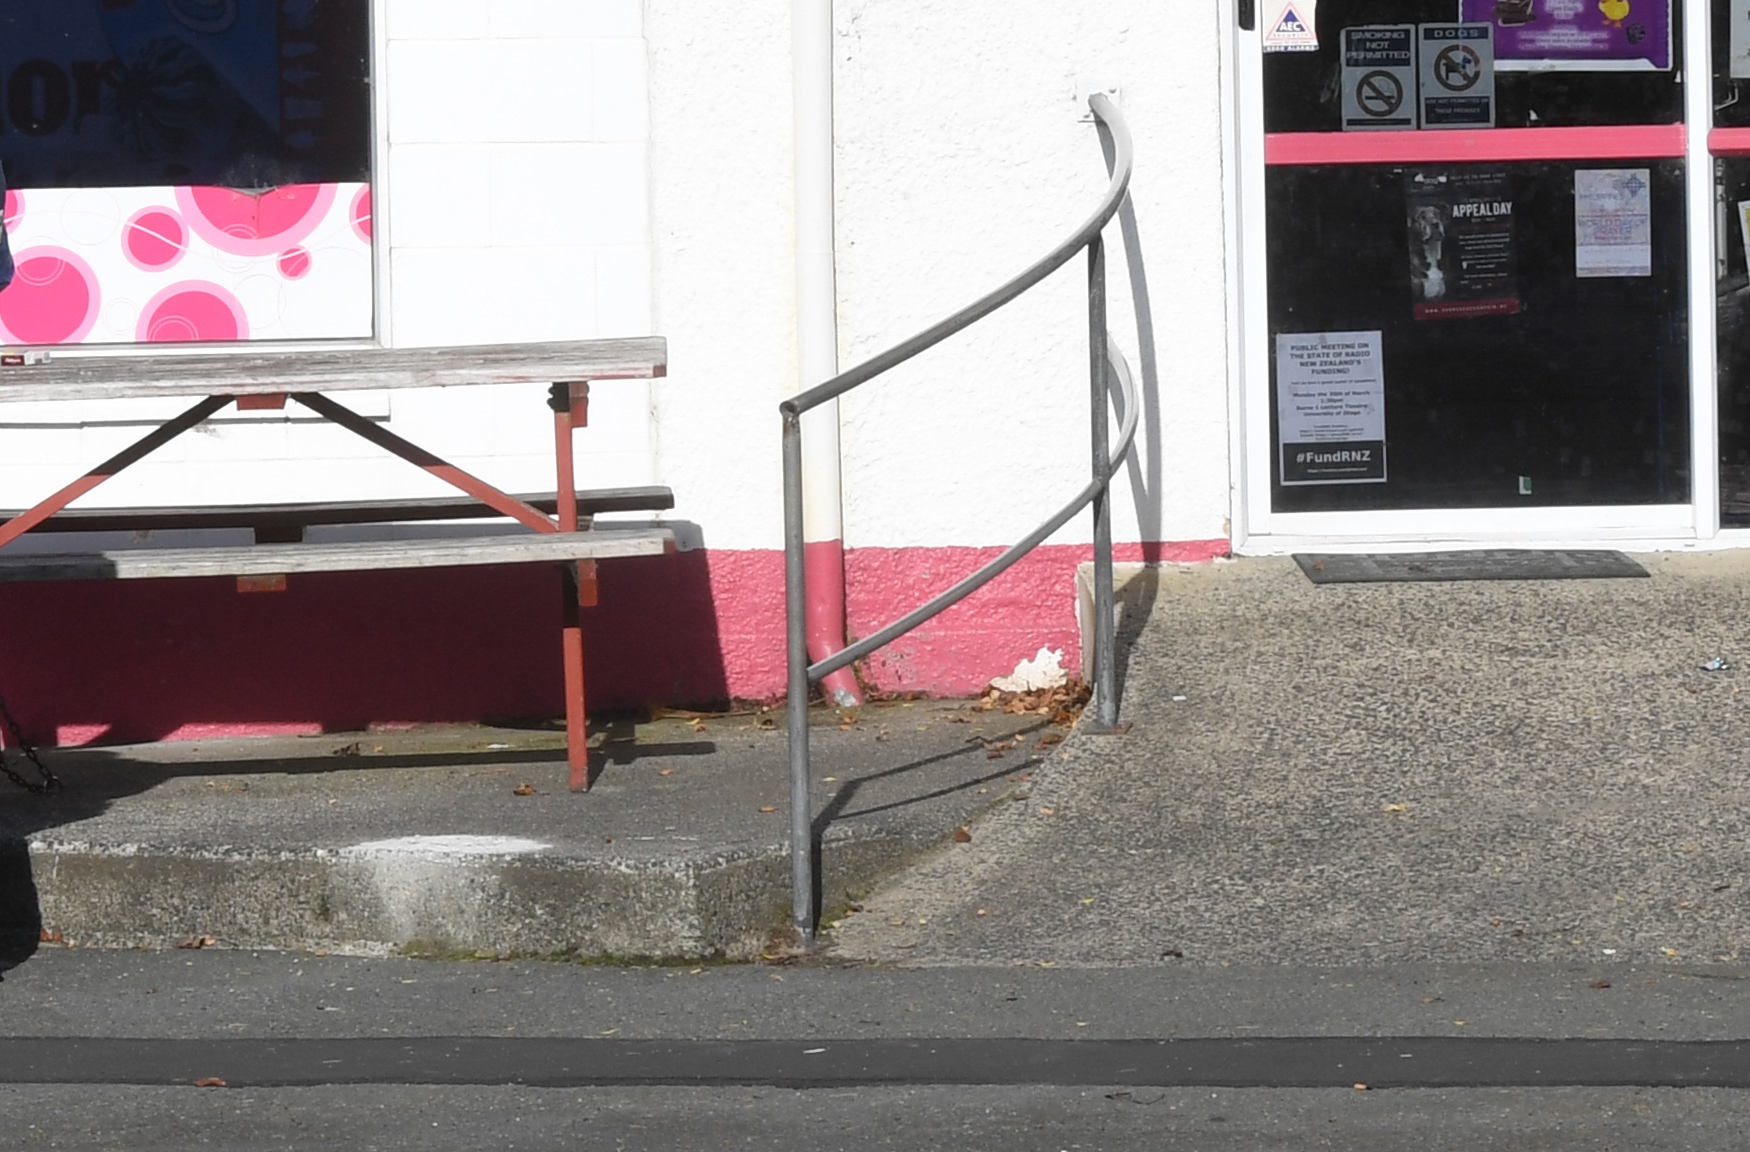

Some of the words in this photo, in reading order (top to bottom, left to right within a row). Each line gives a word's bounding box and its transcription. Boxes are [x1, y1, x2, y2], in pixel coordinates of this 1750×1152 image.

[1279, 22, 1301, 31] AEC
[1350, 31, 1406, 40] SMOKING
[1434, 29, 1479, 38] DOGS
[1366, 40, 1390, 48] NOT
[1346, 51, 1411, 60] PERMITTED
[1452, 203, 1492, 218] APPEAL
[1492, 202, 1513, 216] DAY
[1295, 450, 1372, 464] #FundRNZ
